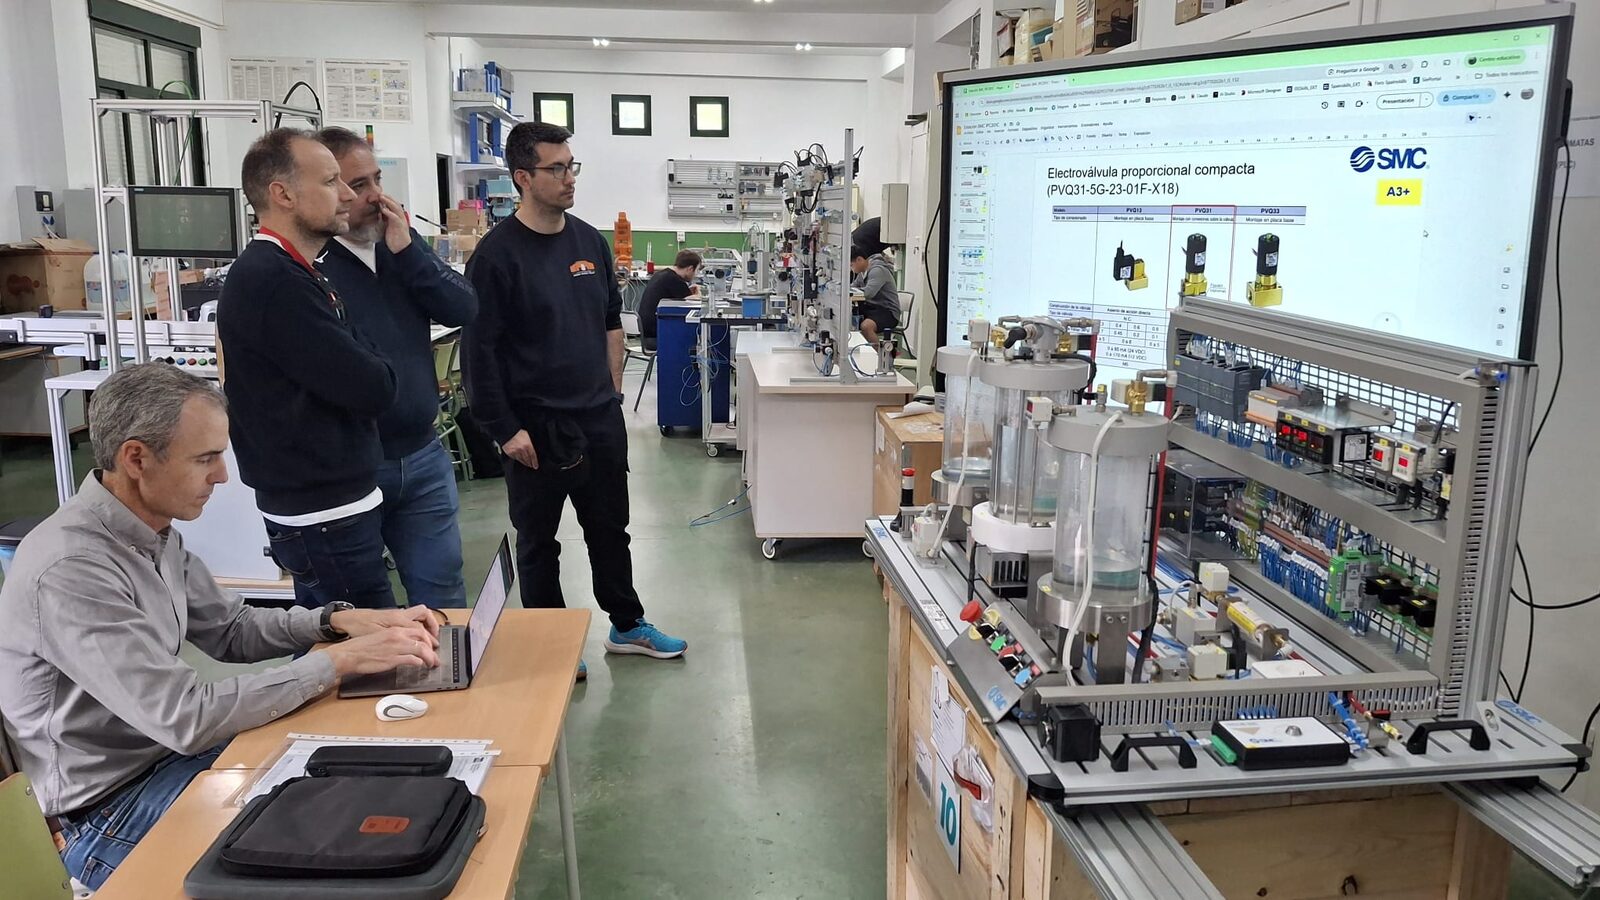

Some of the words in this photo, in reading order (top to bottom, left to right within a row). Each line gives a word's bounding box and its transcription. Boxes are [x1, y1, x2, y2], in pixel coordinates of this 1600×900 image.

[1377, 147, 1427, 170] SMC
[1047, 165, 1118, 179] Electroválvula
[1121, 163, 1191, 180] proporcional
[1194, 162, 1255, 178] compacta
[1047, 182, 1179, 198] (PVQ31-5G-23-01F-X18)
[1386, 186, 1410, 197] A3+
[940, 781, 957, 847] 10
